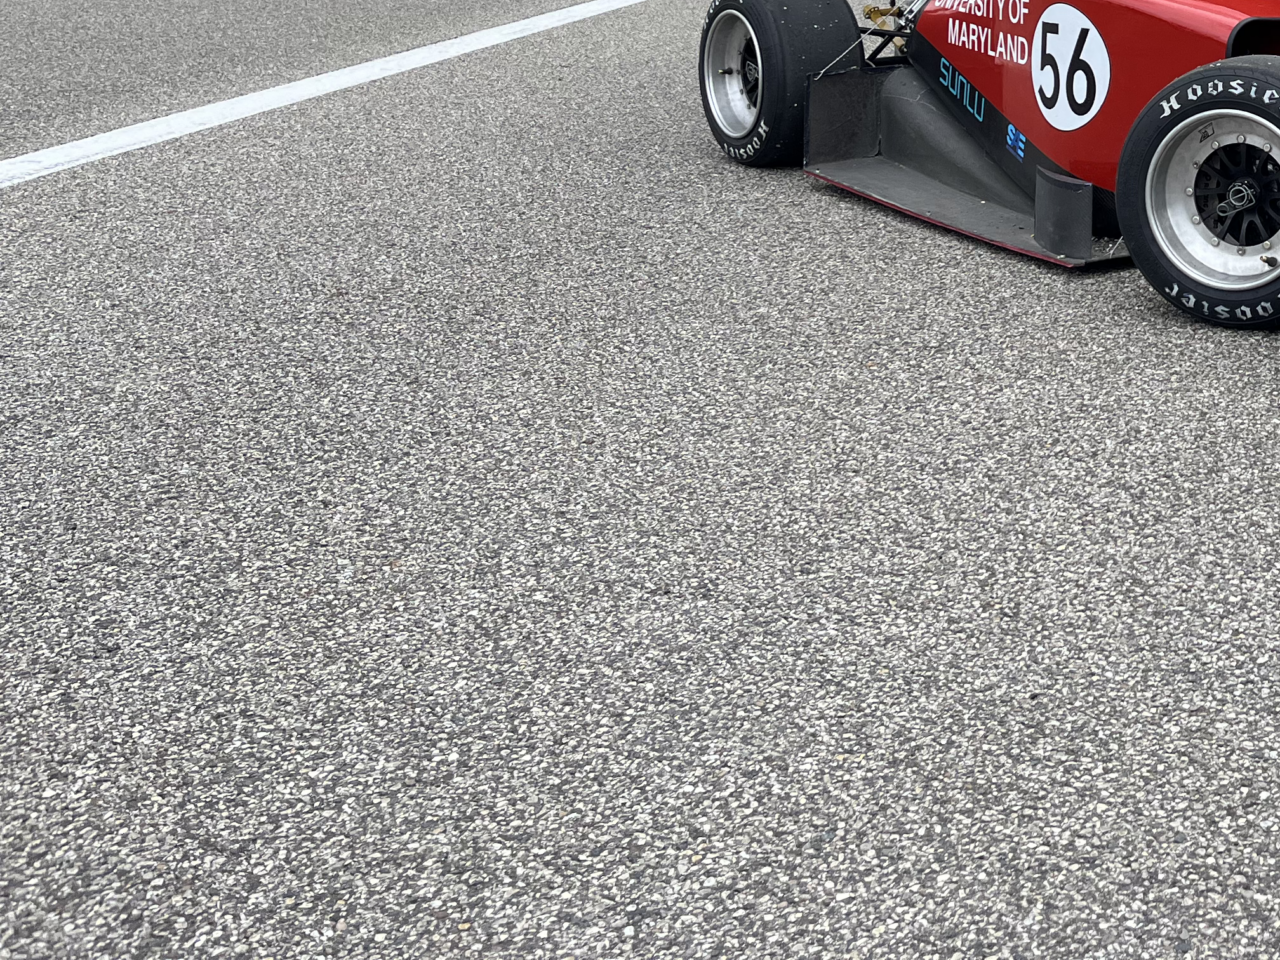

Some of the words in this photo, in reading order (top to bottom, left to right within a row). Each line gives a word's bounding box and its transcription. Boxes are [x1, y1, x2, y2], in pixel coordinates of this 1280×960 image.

[948, 18, 1029, 65] MARYLAND
[1038, 20, 1096, 117] 56
[1006, 124, 1026, 158] SAE
